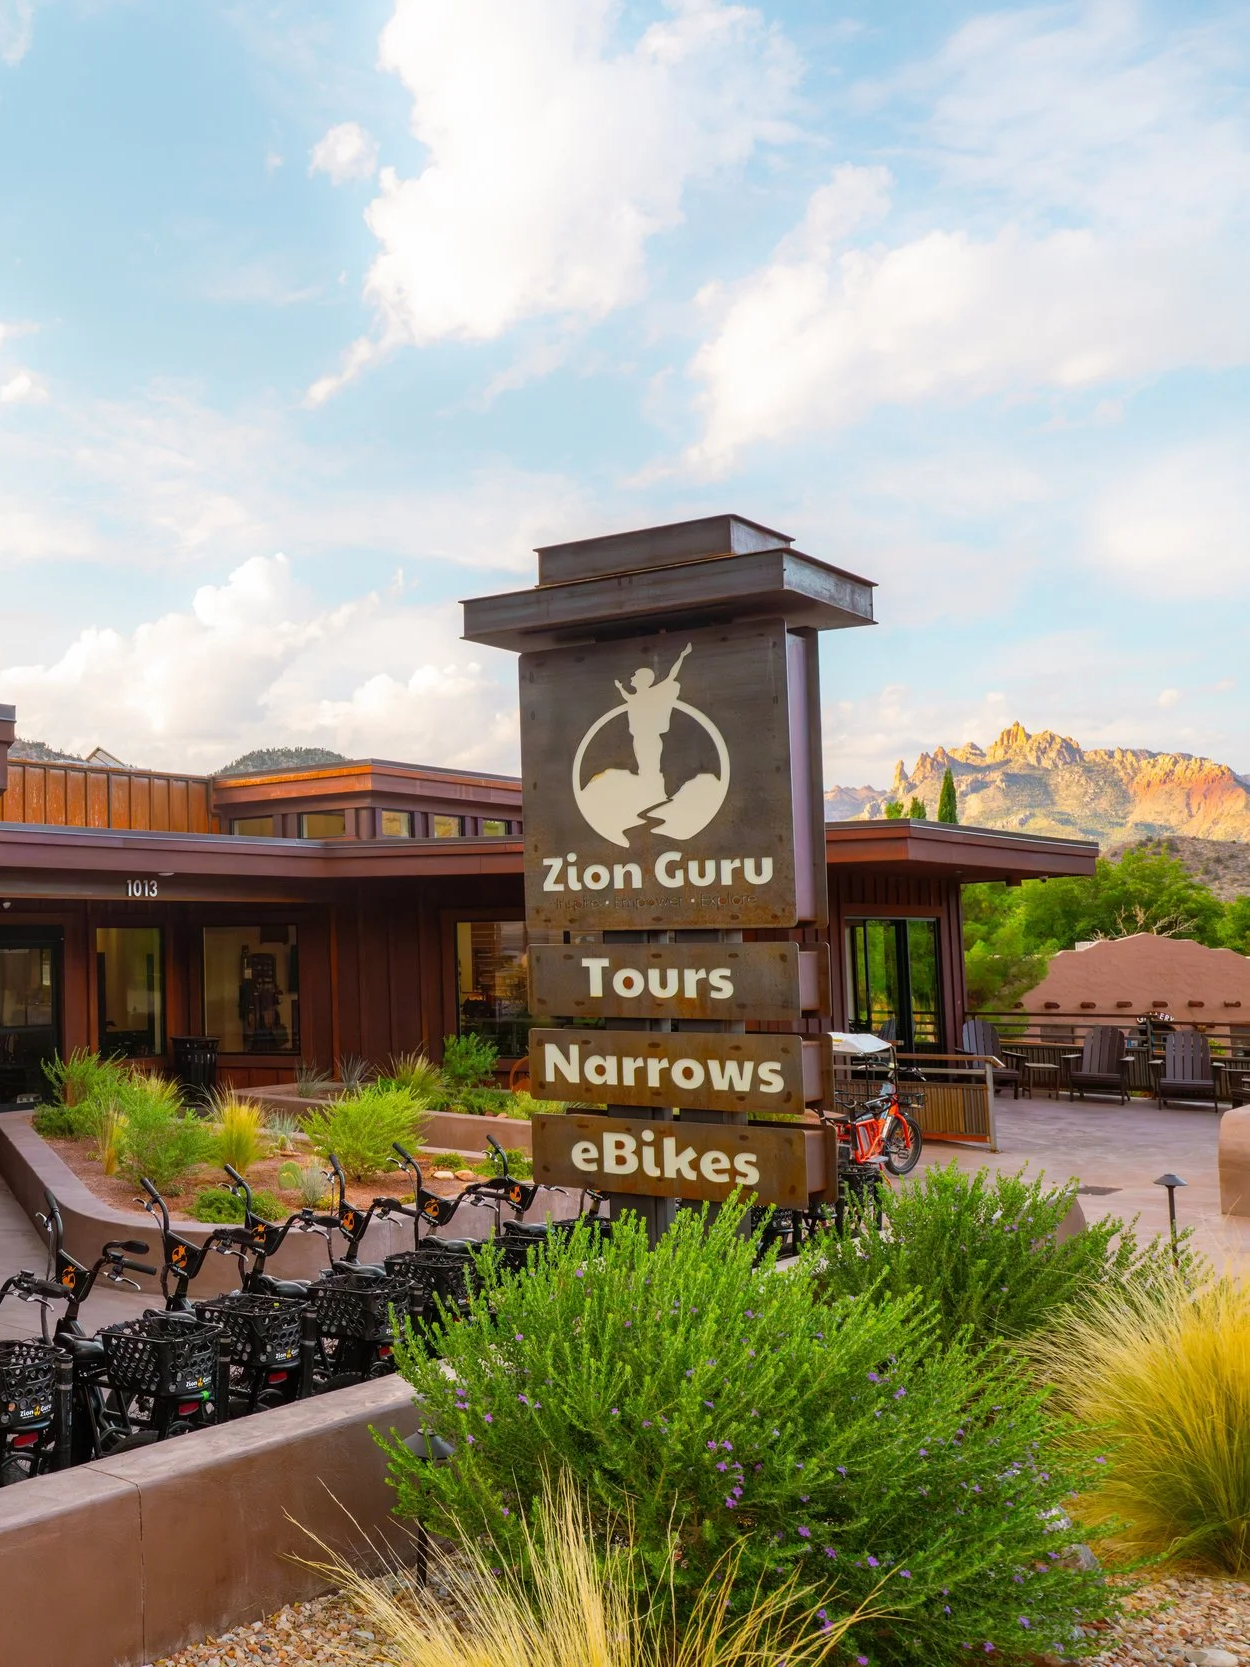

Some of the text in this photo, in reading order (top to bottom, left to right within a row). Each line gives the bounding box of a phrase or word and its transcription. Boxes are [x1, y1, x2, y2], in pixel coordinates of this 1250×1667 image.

[542, 851, 774, 892] Zion Guru
[126, 880, 158, 898] 1013
[613, 896, 683, 909] Empower
[701, 892, 758, 906] Explore
[581, 957, 735, 1000] Tours
[1136, 1011, 1175, 1023] GERY
[544, 1043, 785, 1094] Narrows
[571, 1129, 760, 1186] eBikes
[20, 1409, 34, 1417] Zion
